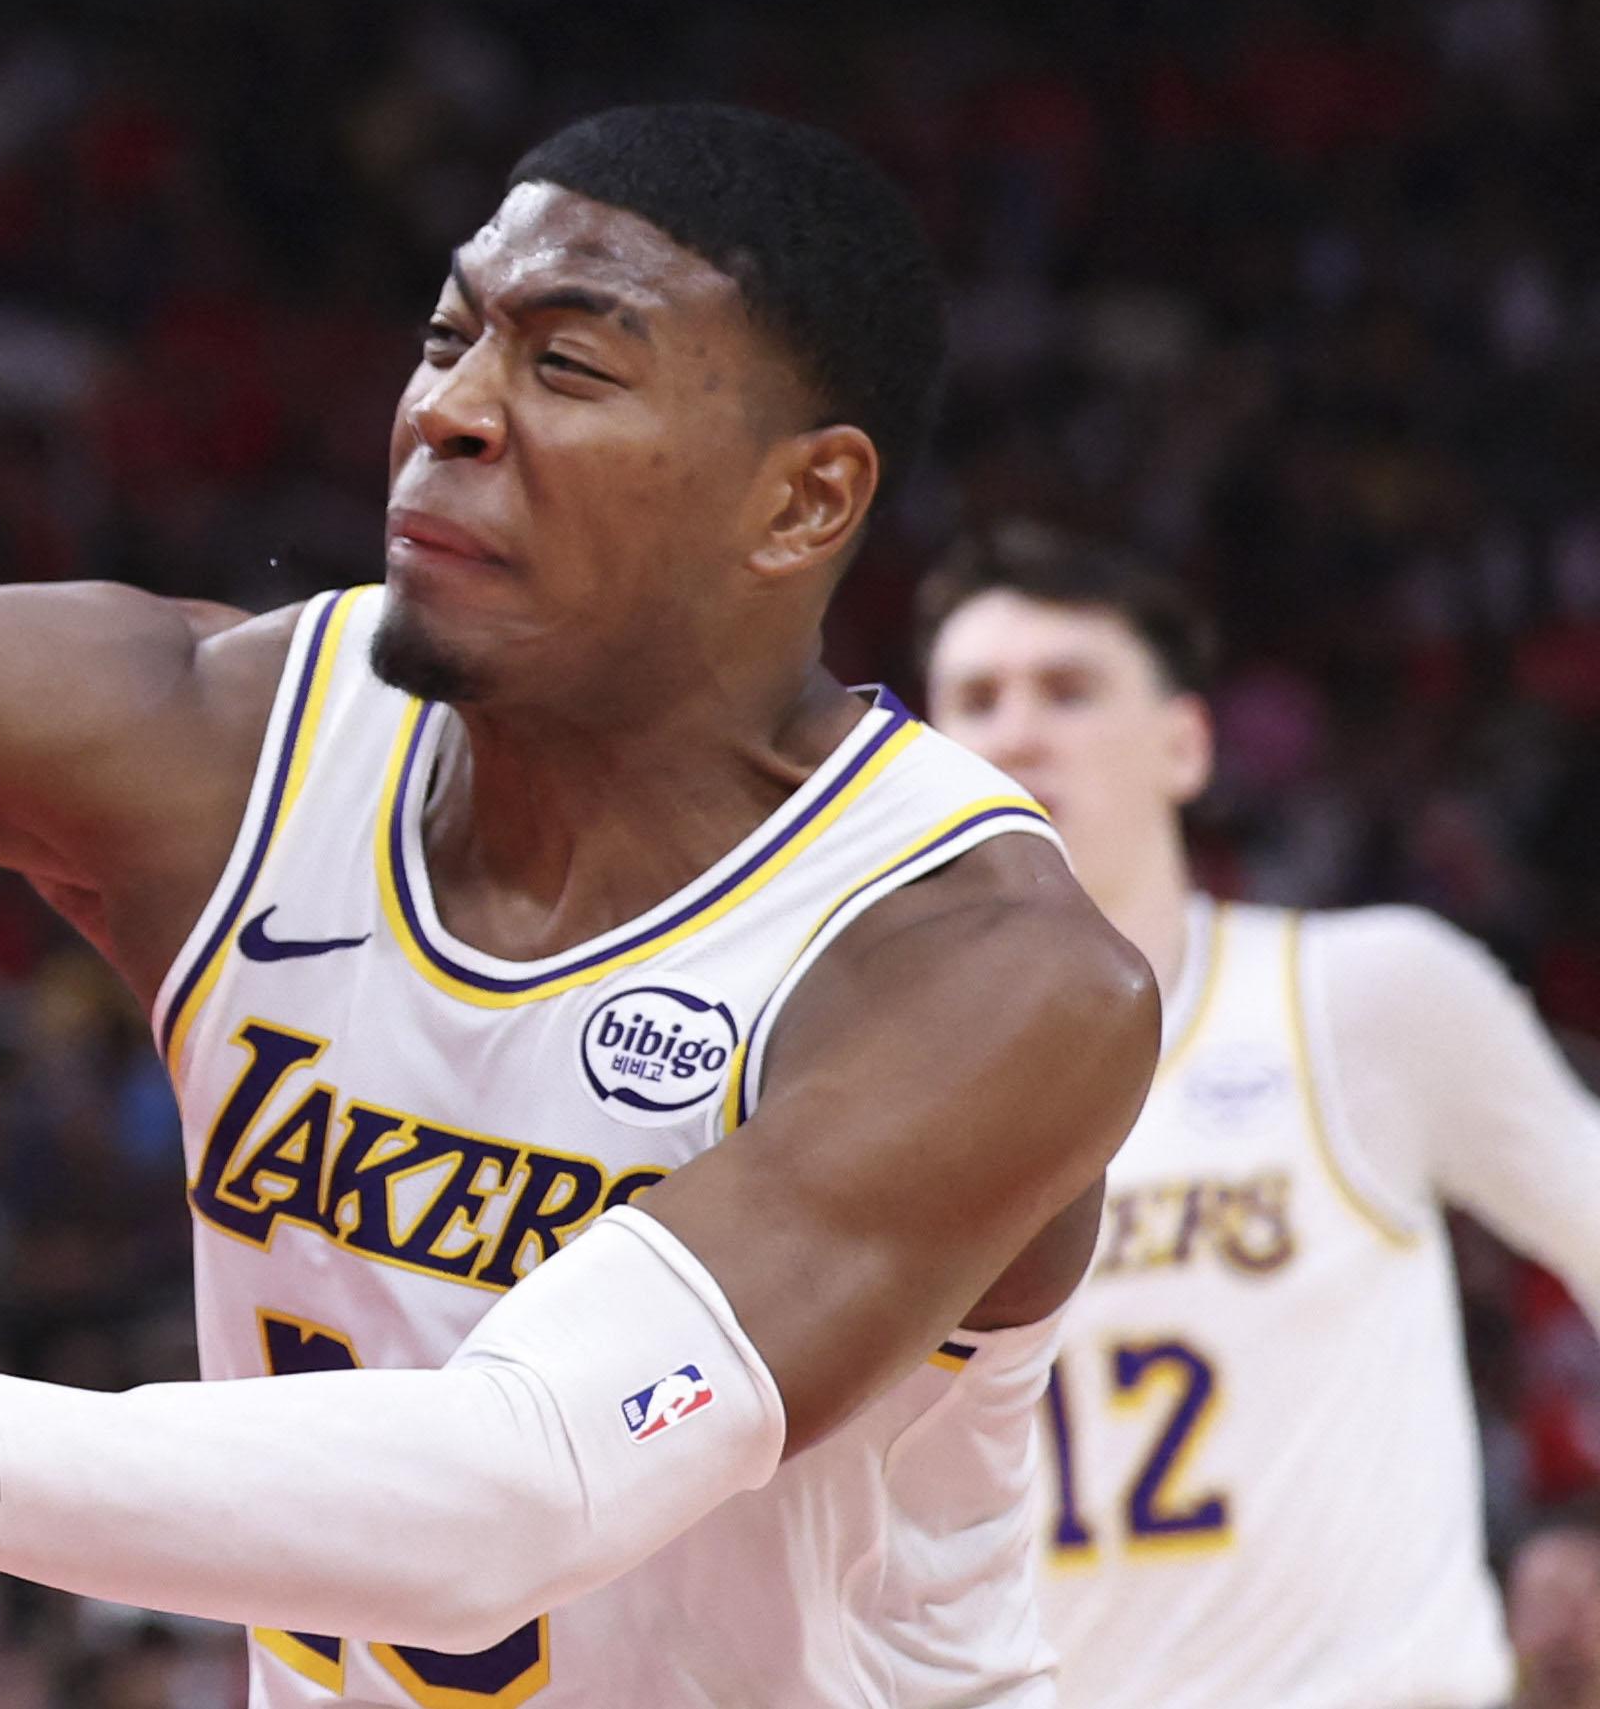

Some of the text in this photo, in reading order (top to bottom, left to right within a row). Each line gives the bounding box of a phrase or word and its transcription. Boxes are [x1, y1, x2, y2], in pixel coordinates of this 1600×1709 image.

[598, 1010, 727, 1079] bibigo
[610, 1054, 664, 1082] 비비고
[1047, 1340, 1237, 1564] 12
